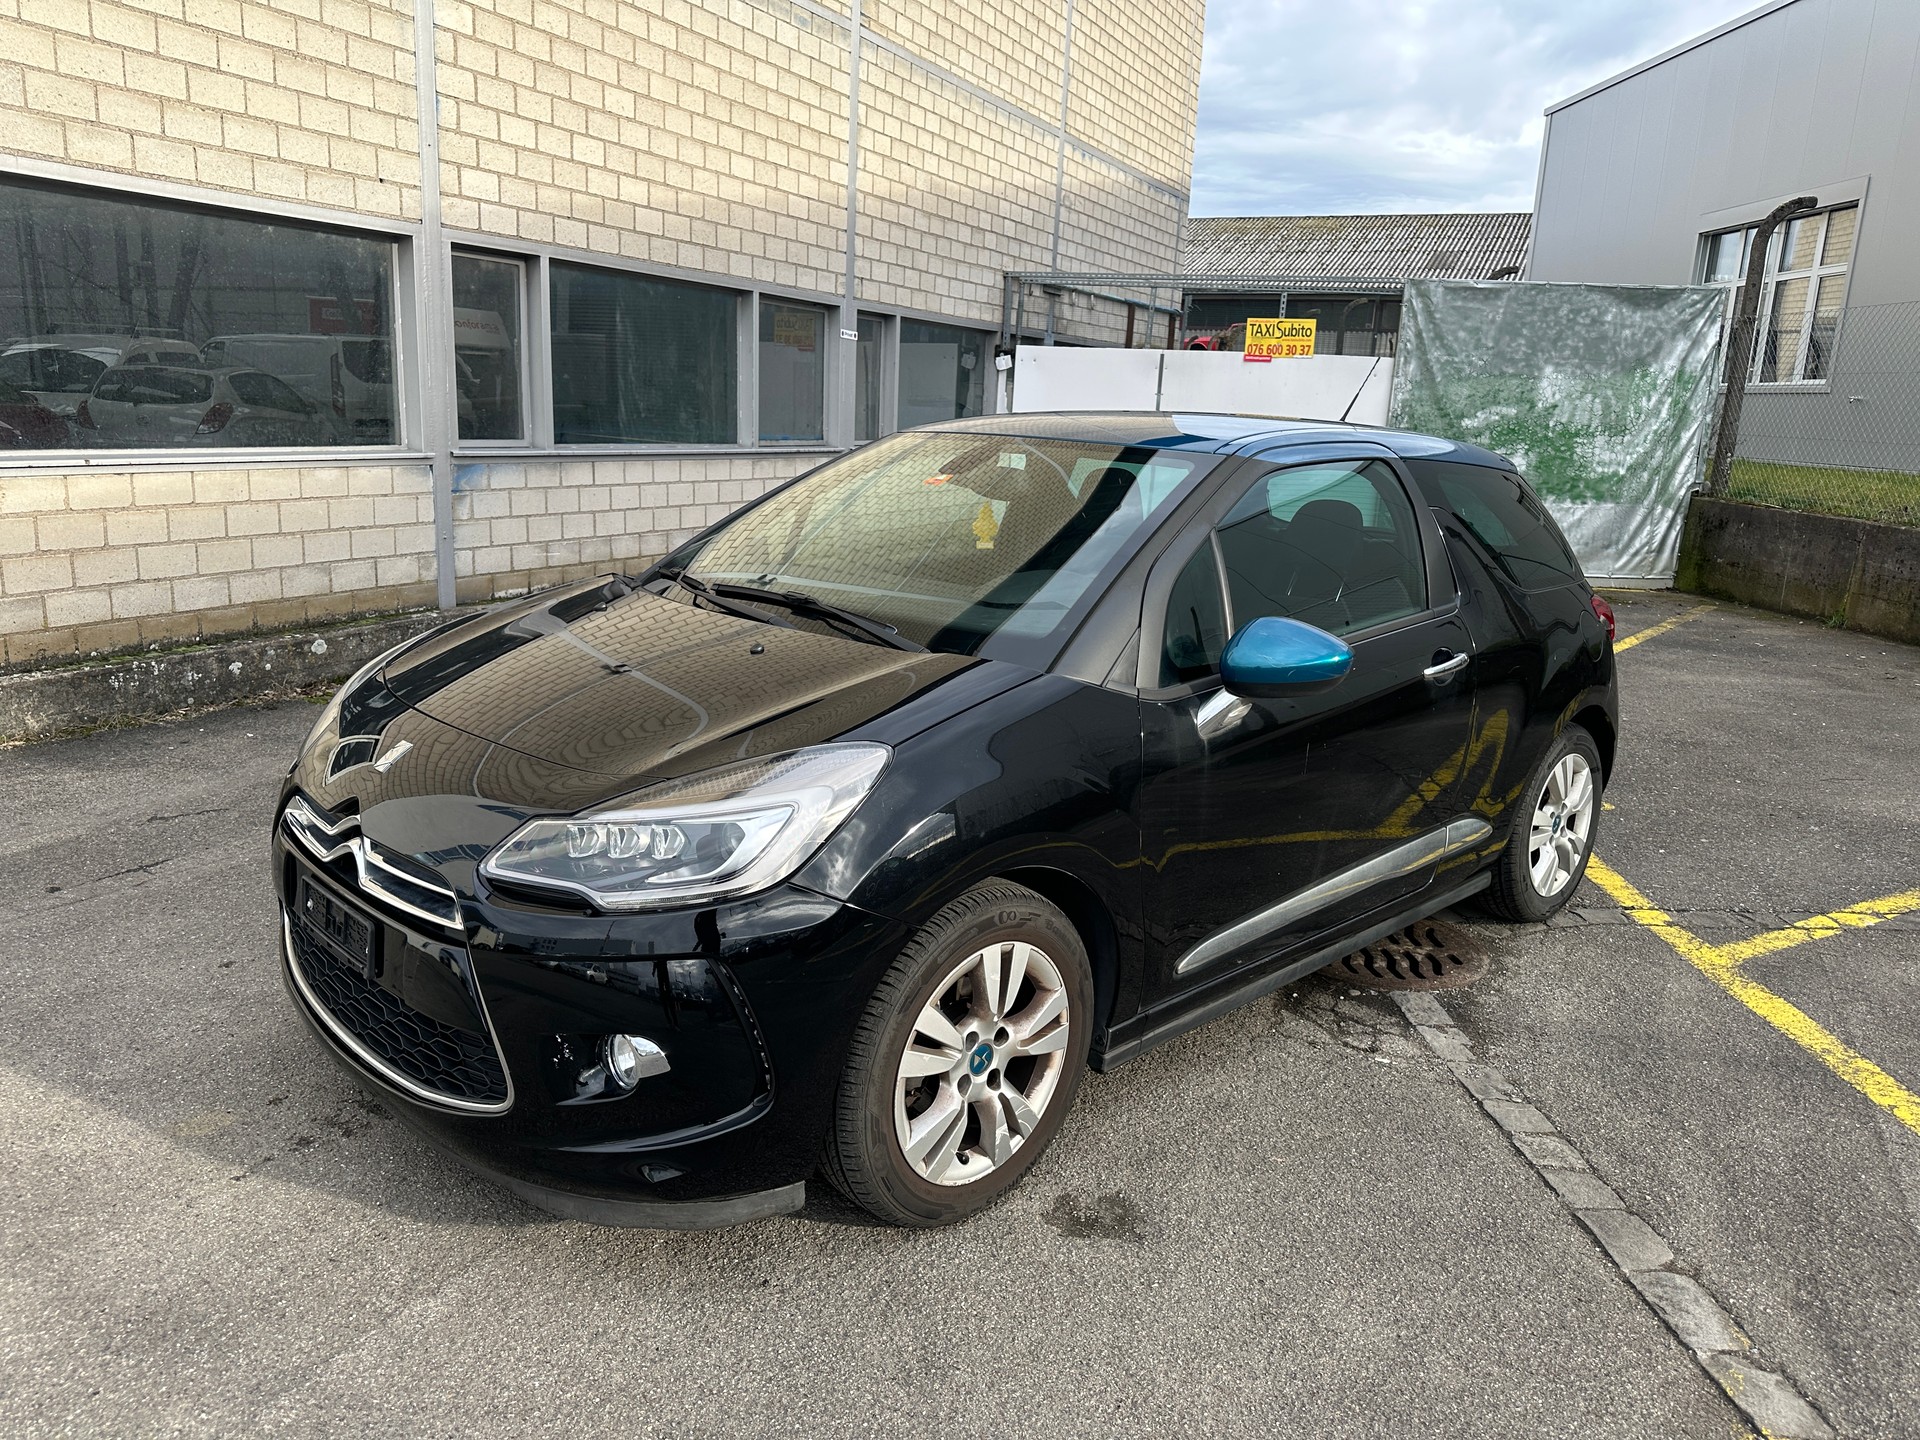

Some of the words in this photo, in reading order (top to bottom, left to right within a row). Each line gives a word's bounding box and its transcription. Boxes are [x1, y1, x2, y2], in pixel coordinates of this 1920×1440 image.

[1247, 344, 1264, 355] 076
[1266, 344, 1283, 355] 600
[1285, 344, 1297, 356] 30
[1299, 344, 1311, 356] 37
